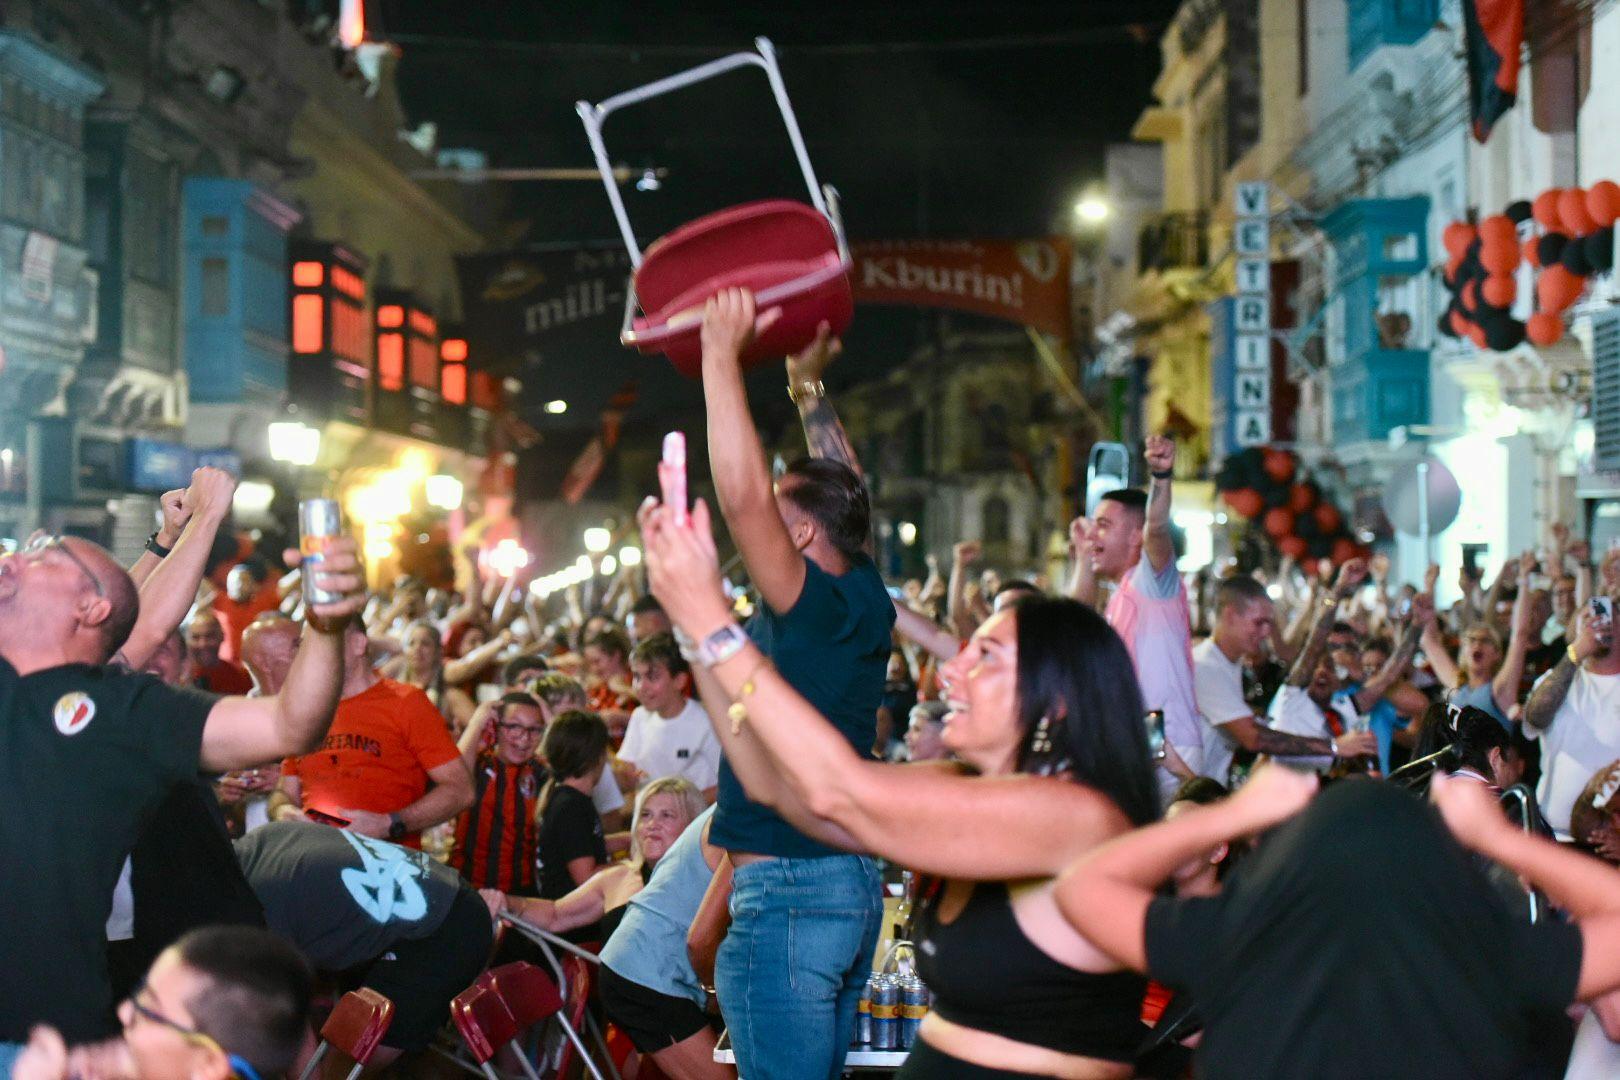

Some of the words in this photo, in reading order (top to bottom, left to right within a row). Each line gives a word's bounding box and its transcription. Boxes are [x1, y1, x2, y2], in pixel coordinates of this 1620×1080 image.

[862, 255, 1024, 309] Kburin!
[1240, 186, 1264, 440] VETRINA
[324, 733, 382, 758] RTANS
